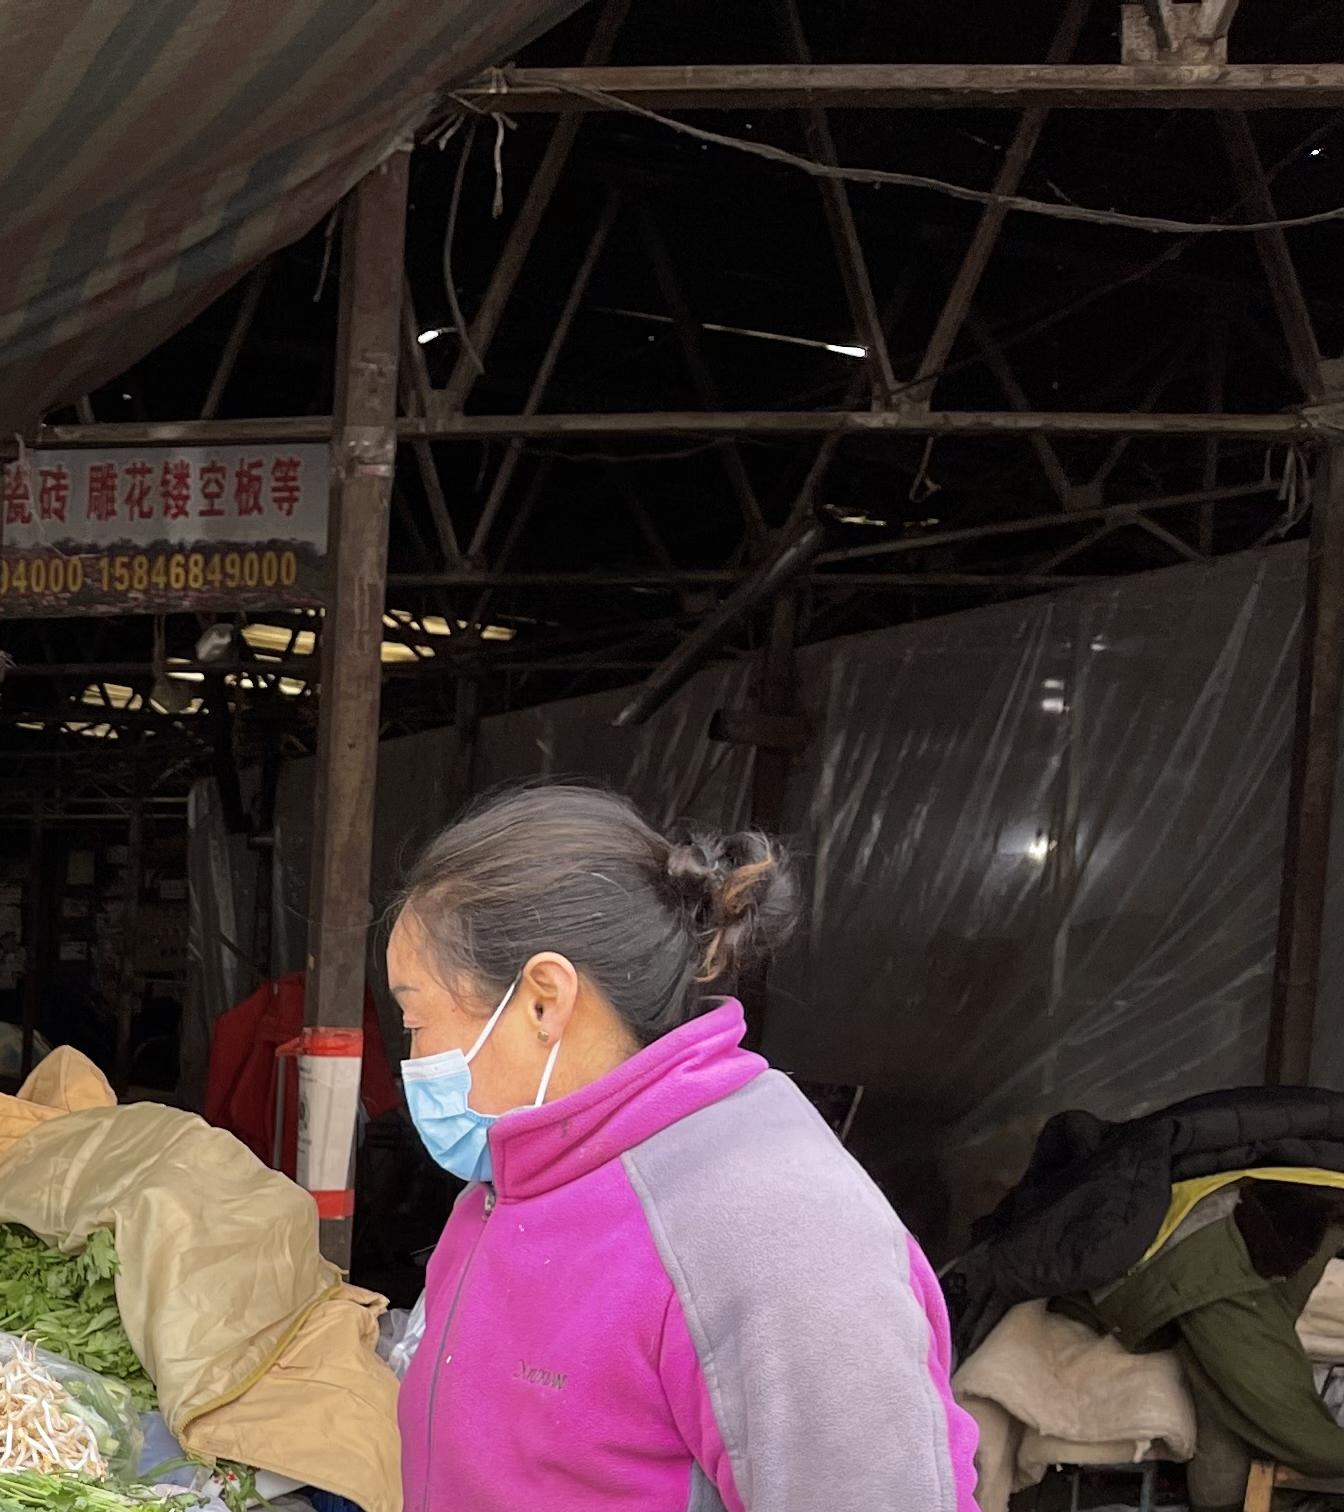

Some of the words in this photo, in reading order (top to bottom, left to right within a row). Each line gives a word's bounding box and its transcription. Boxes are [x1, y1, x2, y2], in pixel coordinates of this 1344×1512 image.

[86, 458, 302, 522] 雕花镂空板等
[99, 551, 297, 591] 15846849000
